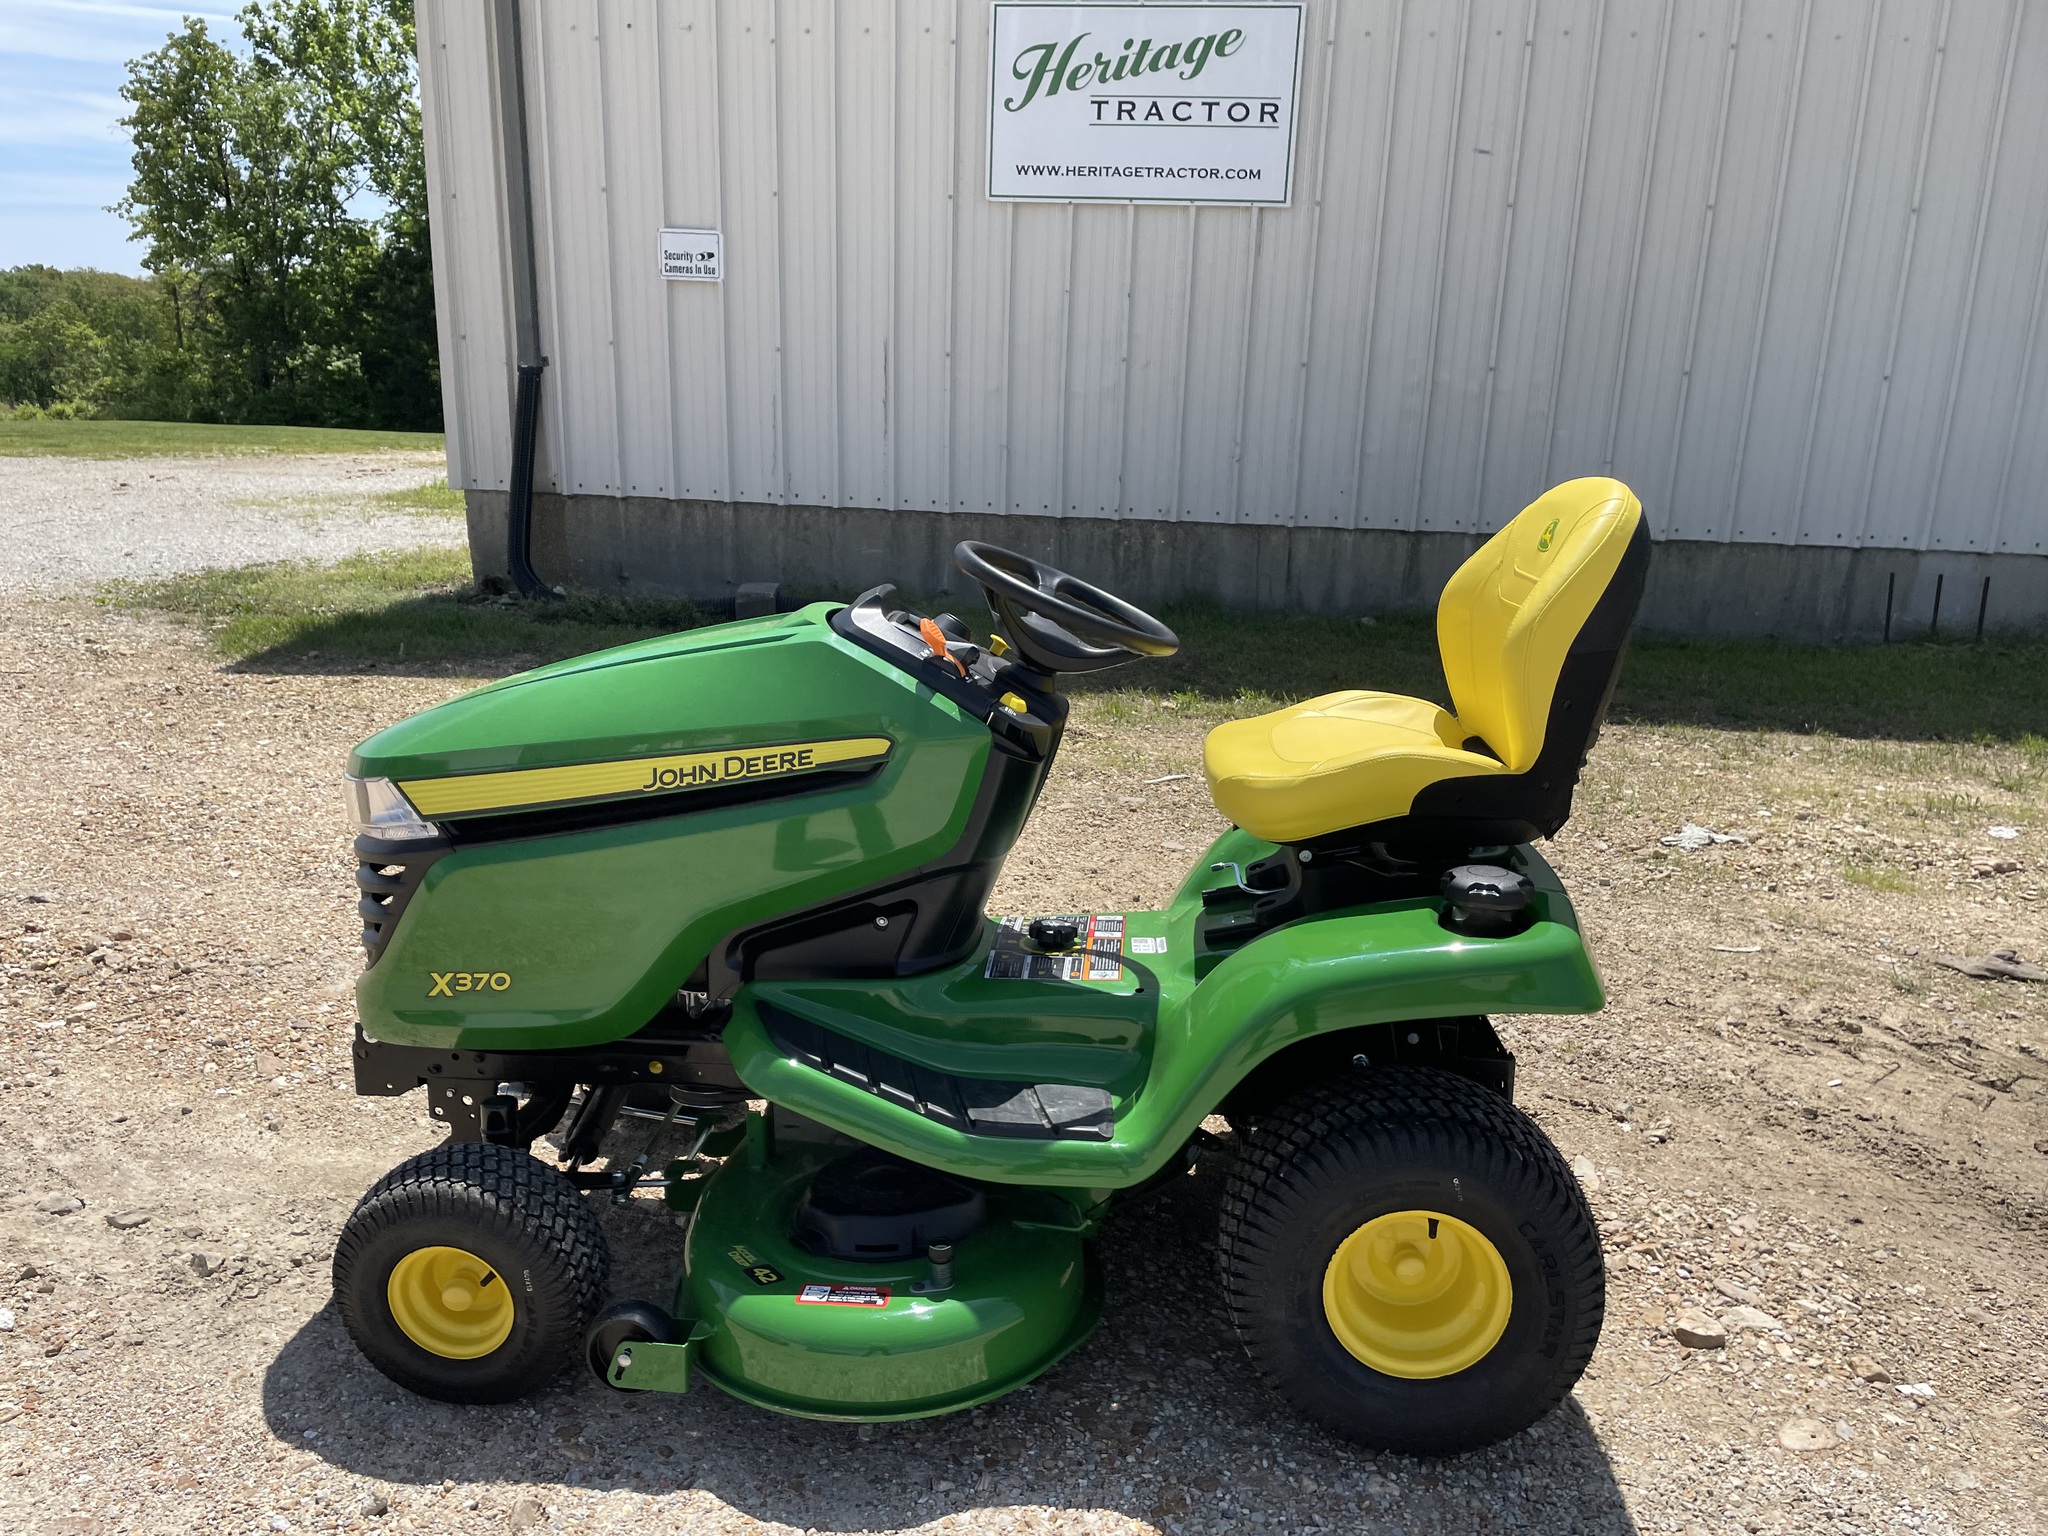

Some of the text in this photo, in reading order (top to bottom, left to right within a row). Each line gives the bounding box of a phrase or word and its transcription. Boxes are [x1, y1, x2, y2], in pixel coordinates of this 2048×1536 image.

[1003, 28, 1247, 112] Heritage
[1090, 100, 1280, 123] TRACTOR
[1015, 164, 1262, 180] WWW.HERITAGETRACTOR.COM
[664, 250, 693, 263] Security
[664, 262, 716, 275] Cameras In Use
[643, 748, 814, 789] JOHN DEERE
[427, 972, 511, 997] X370
[727, 1251, 750, 1267] DEEP
[753, 1268, 778, 1284] 42
